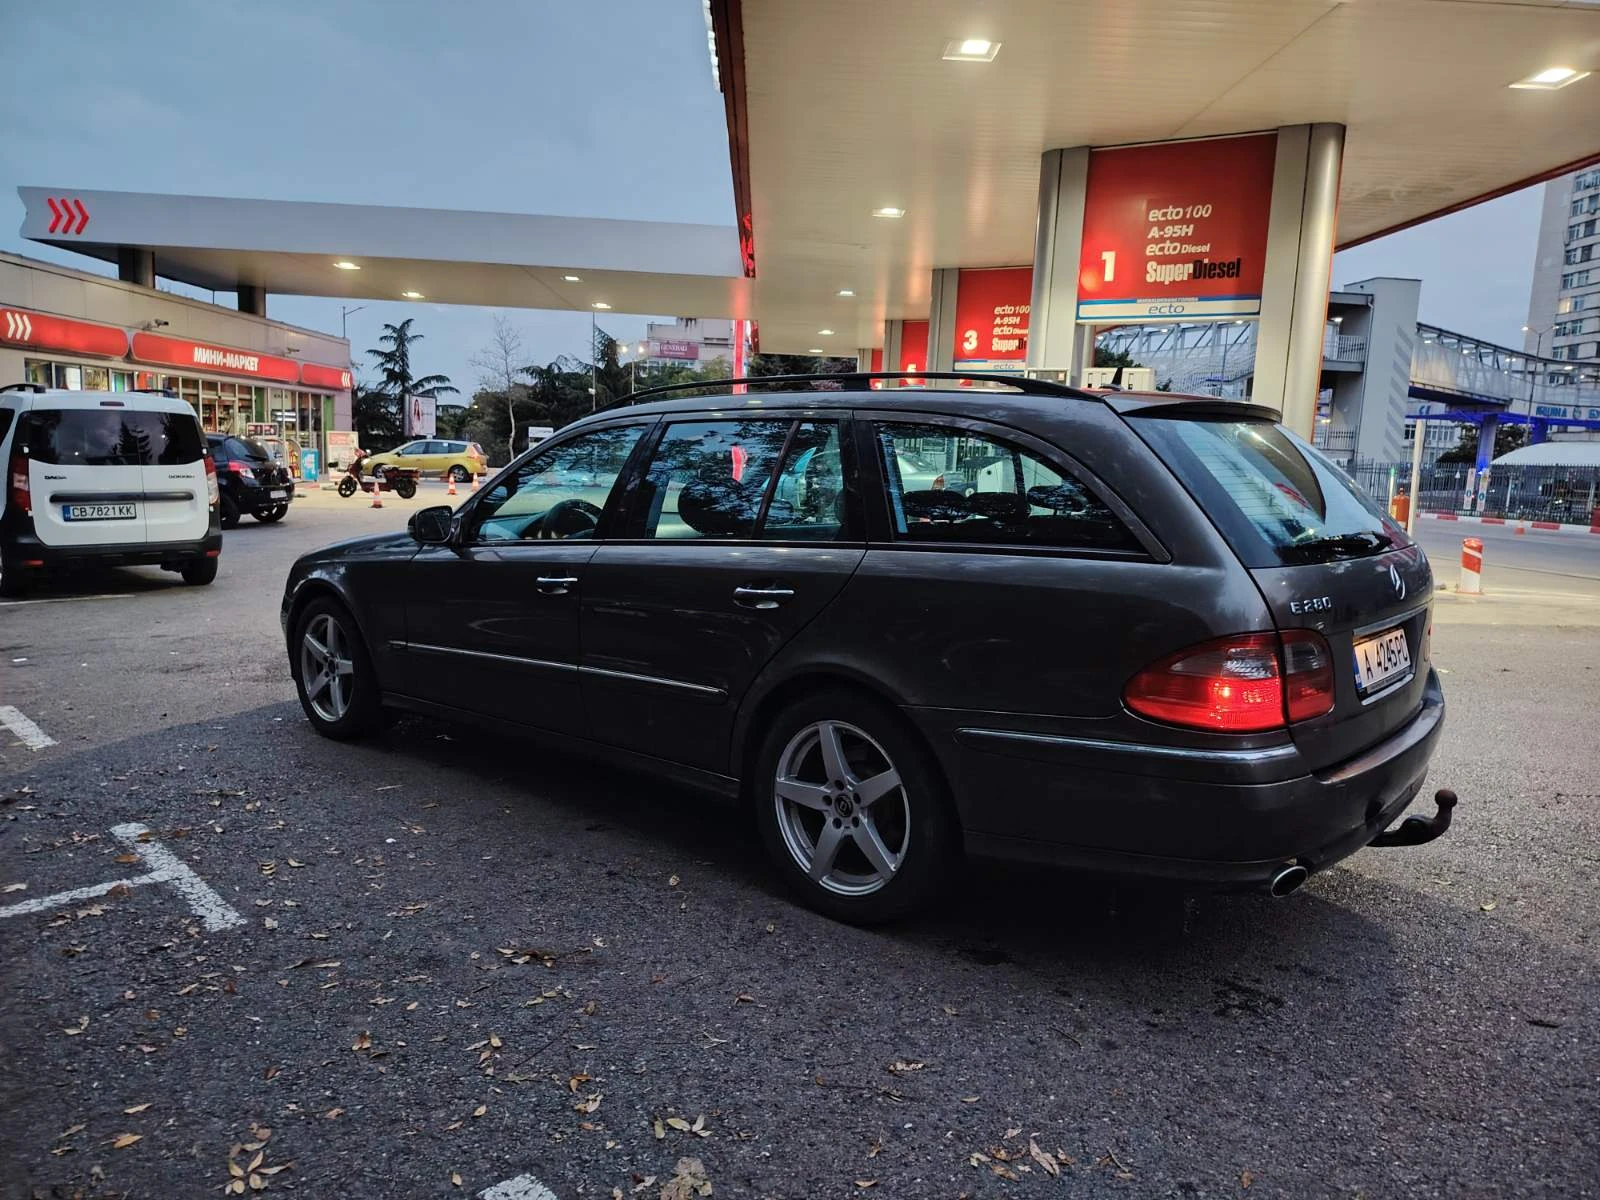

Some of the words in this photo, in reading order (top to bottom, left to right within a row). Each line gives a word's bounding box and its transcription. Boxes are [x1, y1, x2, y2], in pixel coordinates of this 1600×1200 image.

[1149, 205, 1183, 221] ecto
[1185, 204, 1212, 219] 100
[1147, 224, 1194, 239] A-95H
[1146, 240, 1181, 256] ecto
[1181, 243, 1210, 254] Diesel
[1101, 251, 1116, 282] 1
[1146, 257, 1241, 285] SuperDiesel
[994, 305, 1014, 314] ecto
[1015, 305, 1030, 314] 100
[1148, 303, 1185, 315] ecto
[993, 325, 1013, 335] ecto
[963, 329, 978, 351] 3
[992, 337, 1028, 352] SuperDi
[193, 346, 259, 372] МИНИ-МАРКЕТ
[72, 505, 88, 518] CB
[89, 506, 116, 518] 7821
[119, 505, 135, 517] KK
[1290, 602, 1301, 615] E
[1304, 597, 1332, 613] 280
[1363, 648, 1374, 680] A
